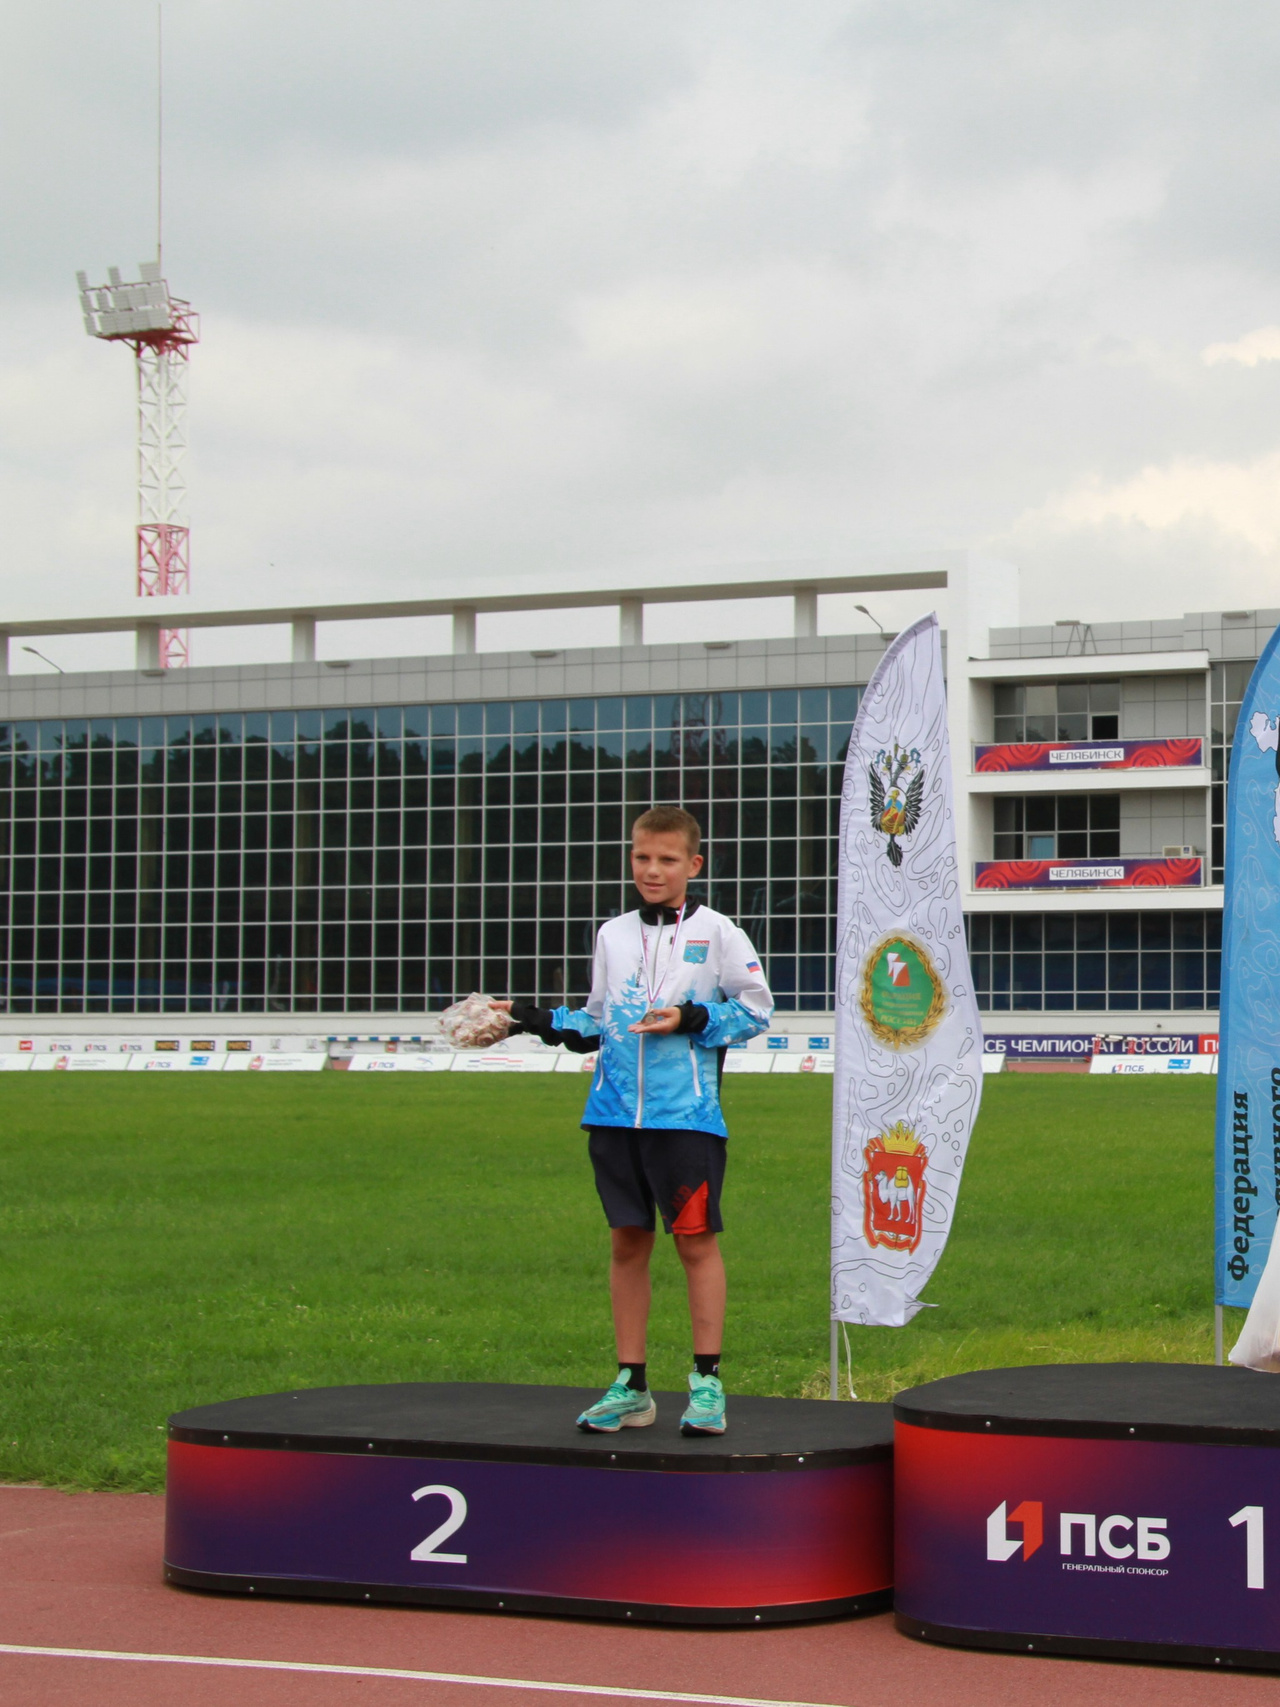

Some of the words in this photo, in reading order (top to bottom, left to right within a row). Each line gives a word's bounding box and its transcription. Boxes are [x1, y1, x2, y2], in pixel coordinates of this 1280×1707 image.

[1051, 750, 1122, 761] ЧЕЛЯБИНСК
[1051, 867, 1122, 879] ЧЕЛЯБИНСК
[1227, 1090, 1258, 1281] Федерация
[410, 1484, 468, 1564] 2
[1060, 1512, 1171, 1561] ПСБ
[1228, 1505, 1265, 1589] 1
[1062, 1562, 1125, 1574] ГЕНЕРАЛЬНЫЙ
[1126, 1566, 1169, 1576] СПОНСОР
